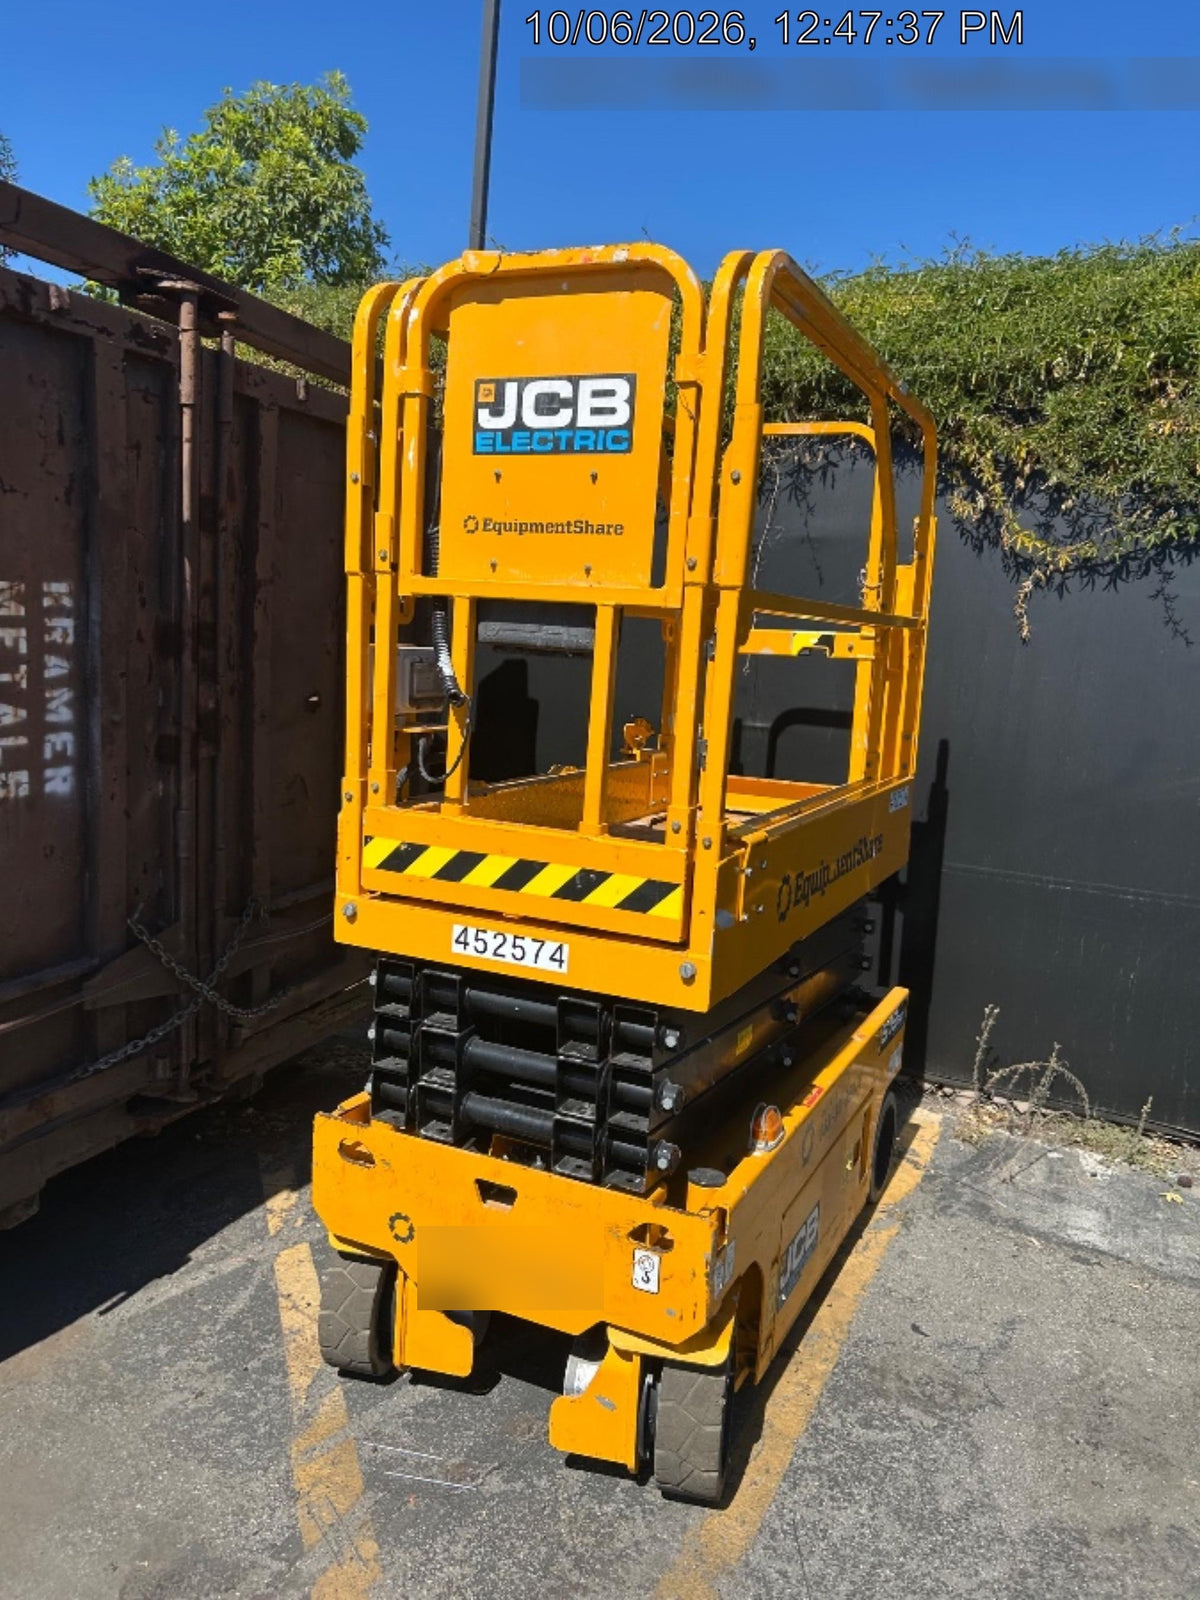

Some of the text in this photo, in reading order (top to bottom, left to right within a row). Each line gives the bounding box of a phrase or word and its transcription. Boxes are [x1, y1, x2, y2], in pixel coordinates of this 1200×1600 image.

[477, 378, 631, 430] JCB
[475, 429, 630, 453] ELECTRIC
[482, 517, 625, 536] EquipmentShare
[43, 580, 75, 794] KRAMER
[453, 925, 566, 969] 452574
[780, 1206, 819, 1291] JCB
